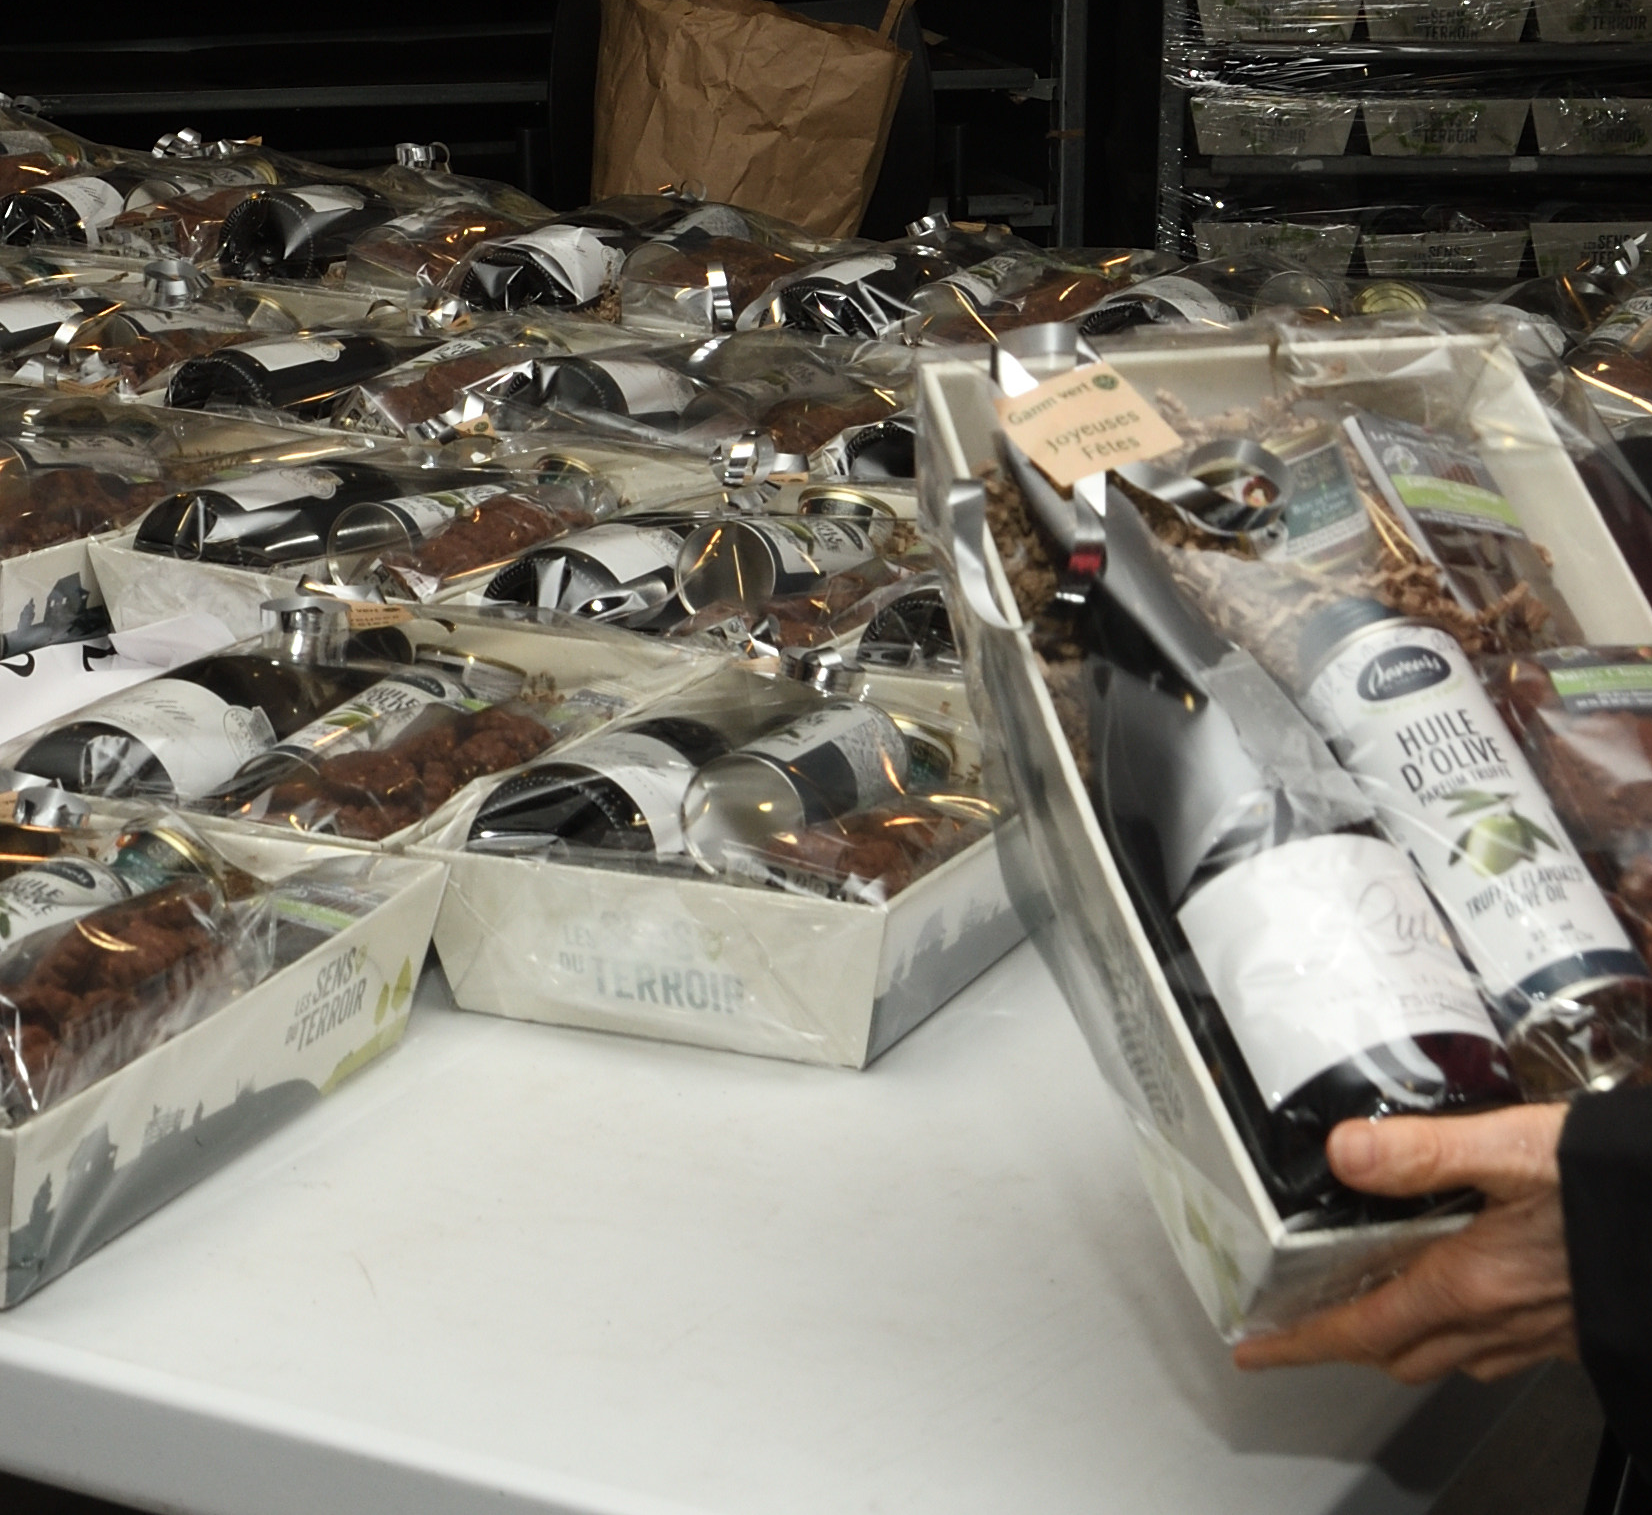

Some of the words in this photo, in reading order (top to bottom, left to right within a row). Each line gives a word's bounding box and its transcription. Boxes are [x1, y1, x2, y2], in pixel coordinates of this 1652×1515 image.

[1592, 16, 1646, 30] TERROIR
[1008, 396, 1058, 426] Gamm
[1058, 380, 1092, 401] vert
[1045, 408, 1141, 455] Joyeuses
[1081, 435, 1141, 462] Fêtes
[1396, 708, 1480, 758] HUILE
[1400, 736, 1508, 794] D'OLIVE
[312, 945, 358, 1005] SENS
[590, 955, 746, 1015] TERROIR
[296, 976, 368, 1052] TERROIR
